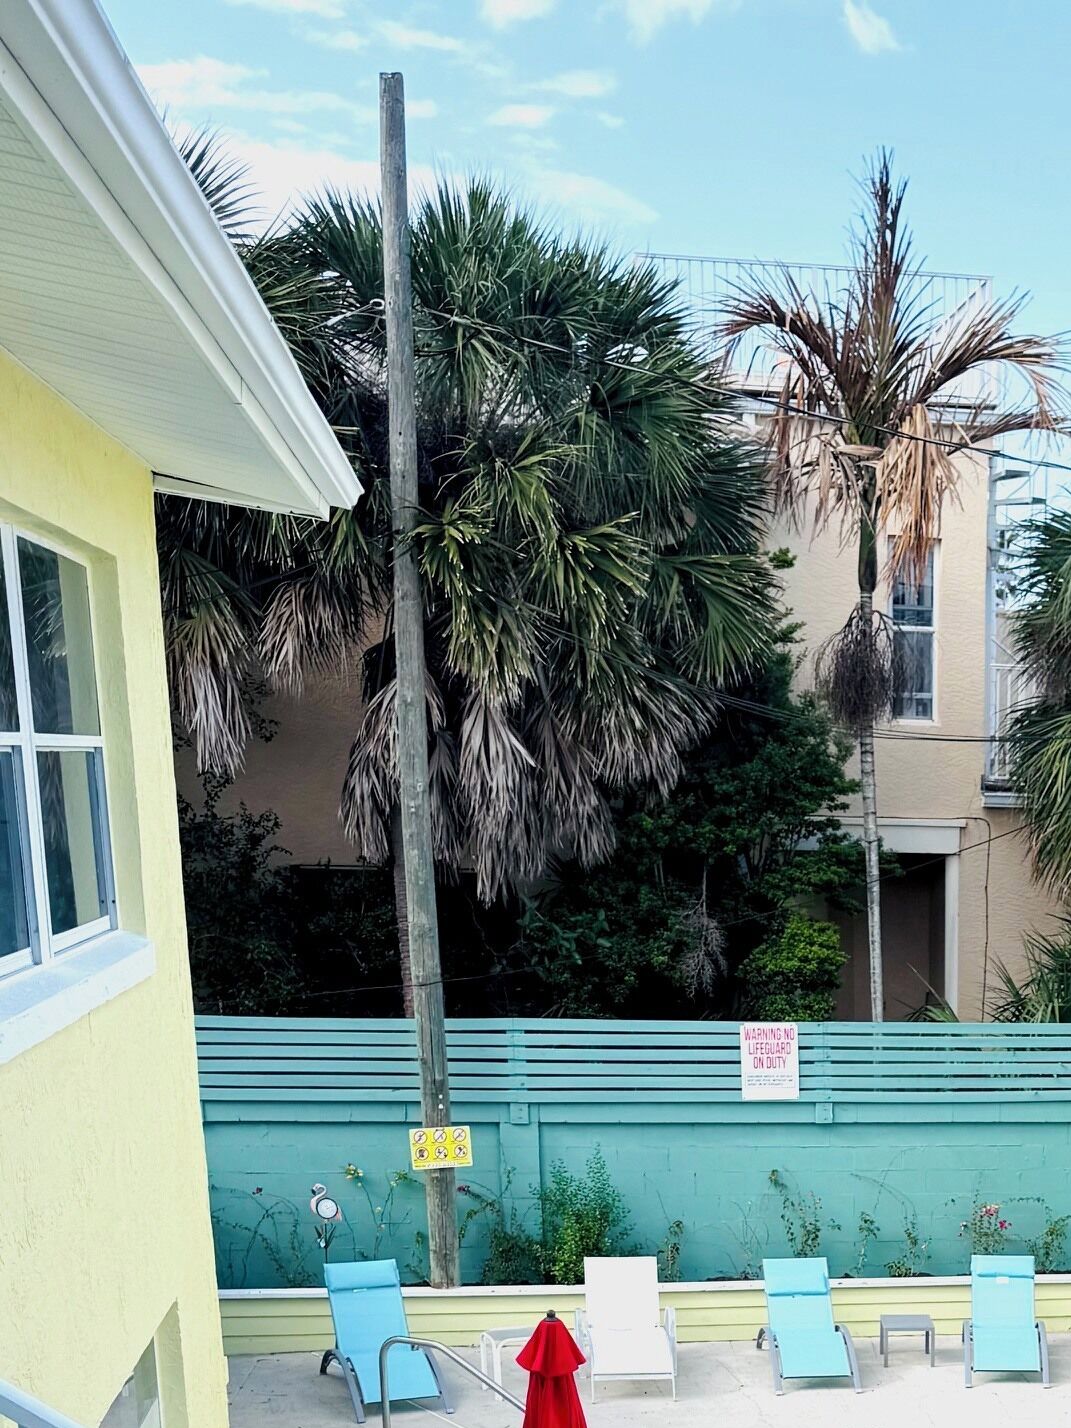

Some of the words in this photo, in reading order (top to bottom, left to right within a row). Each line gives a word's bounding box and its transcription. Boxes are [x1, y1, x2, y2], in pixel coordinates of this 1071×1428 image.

[744, 1026, 781, 1040] WARNING
[784, 1028, 795, 1040] NO
[748, 1042, 791, 1055] LIFEGUARD
[753, 1056, 764, 1069] ON
[766, 1056, 787, 1069] DUTY
